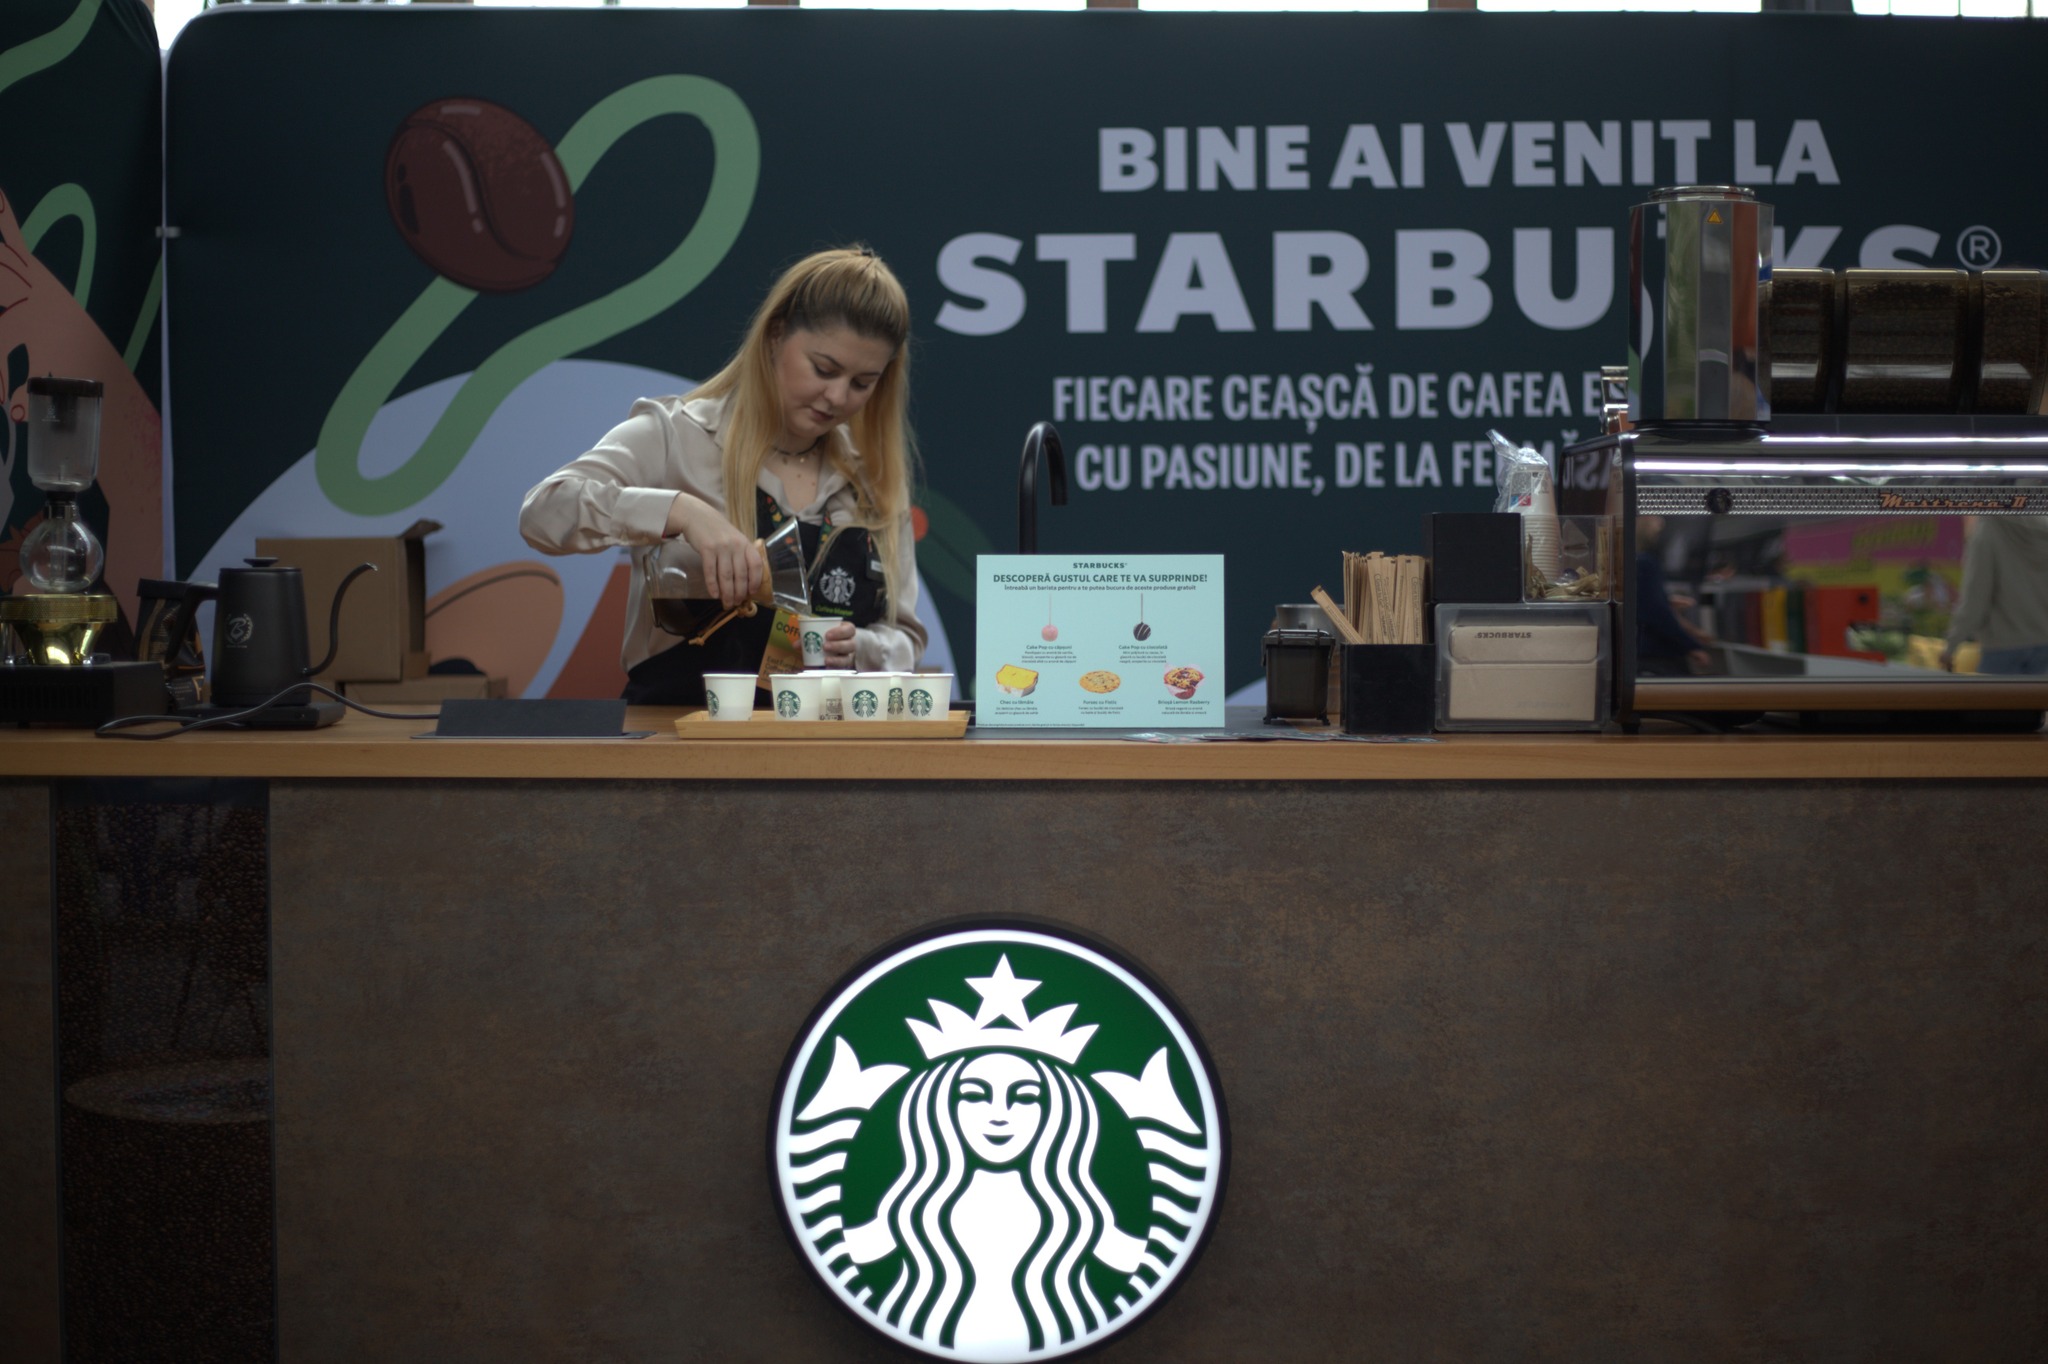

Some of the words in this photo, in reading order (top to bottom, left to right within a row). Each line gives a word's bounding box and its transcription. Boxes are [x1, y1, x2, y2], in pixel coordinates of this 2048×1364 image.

[1099, 125, 1310, 192] BINE
[1329, 123, 1424, 189] AI
[1445, 119, 1711, 187] VENIT
[1733, 119, 1840, 185] LA
[1053, 374, 1213, 421] FIECARE
[1222, 363, 1379, 433] CEAȘCĂ
[1389, 373, 1438, 418] DE
[1448, 371, 1572, 417] CAFEA
[1075, 445, 1130, 490] CU
[1141, 442, 1325, 496] PASIUNE,
[1336, 442, 1384, 487] DE
[1396, 442, 1442, 487] LA
[993, 572, 1051, 583] DESCOPERĂ
[1053, 574, 1091, 583] GUSTUL
[1093, 574, 1118, 583] CARE
[1120, 574, 1131, 583] TE
[1133, 574, 1147, 583] VA
[1149, 574, 1208, 583] SURPRINDE!
